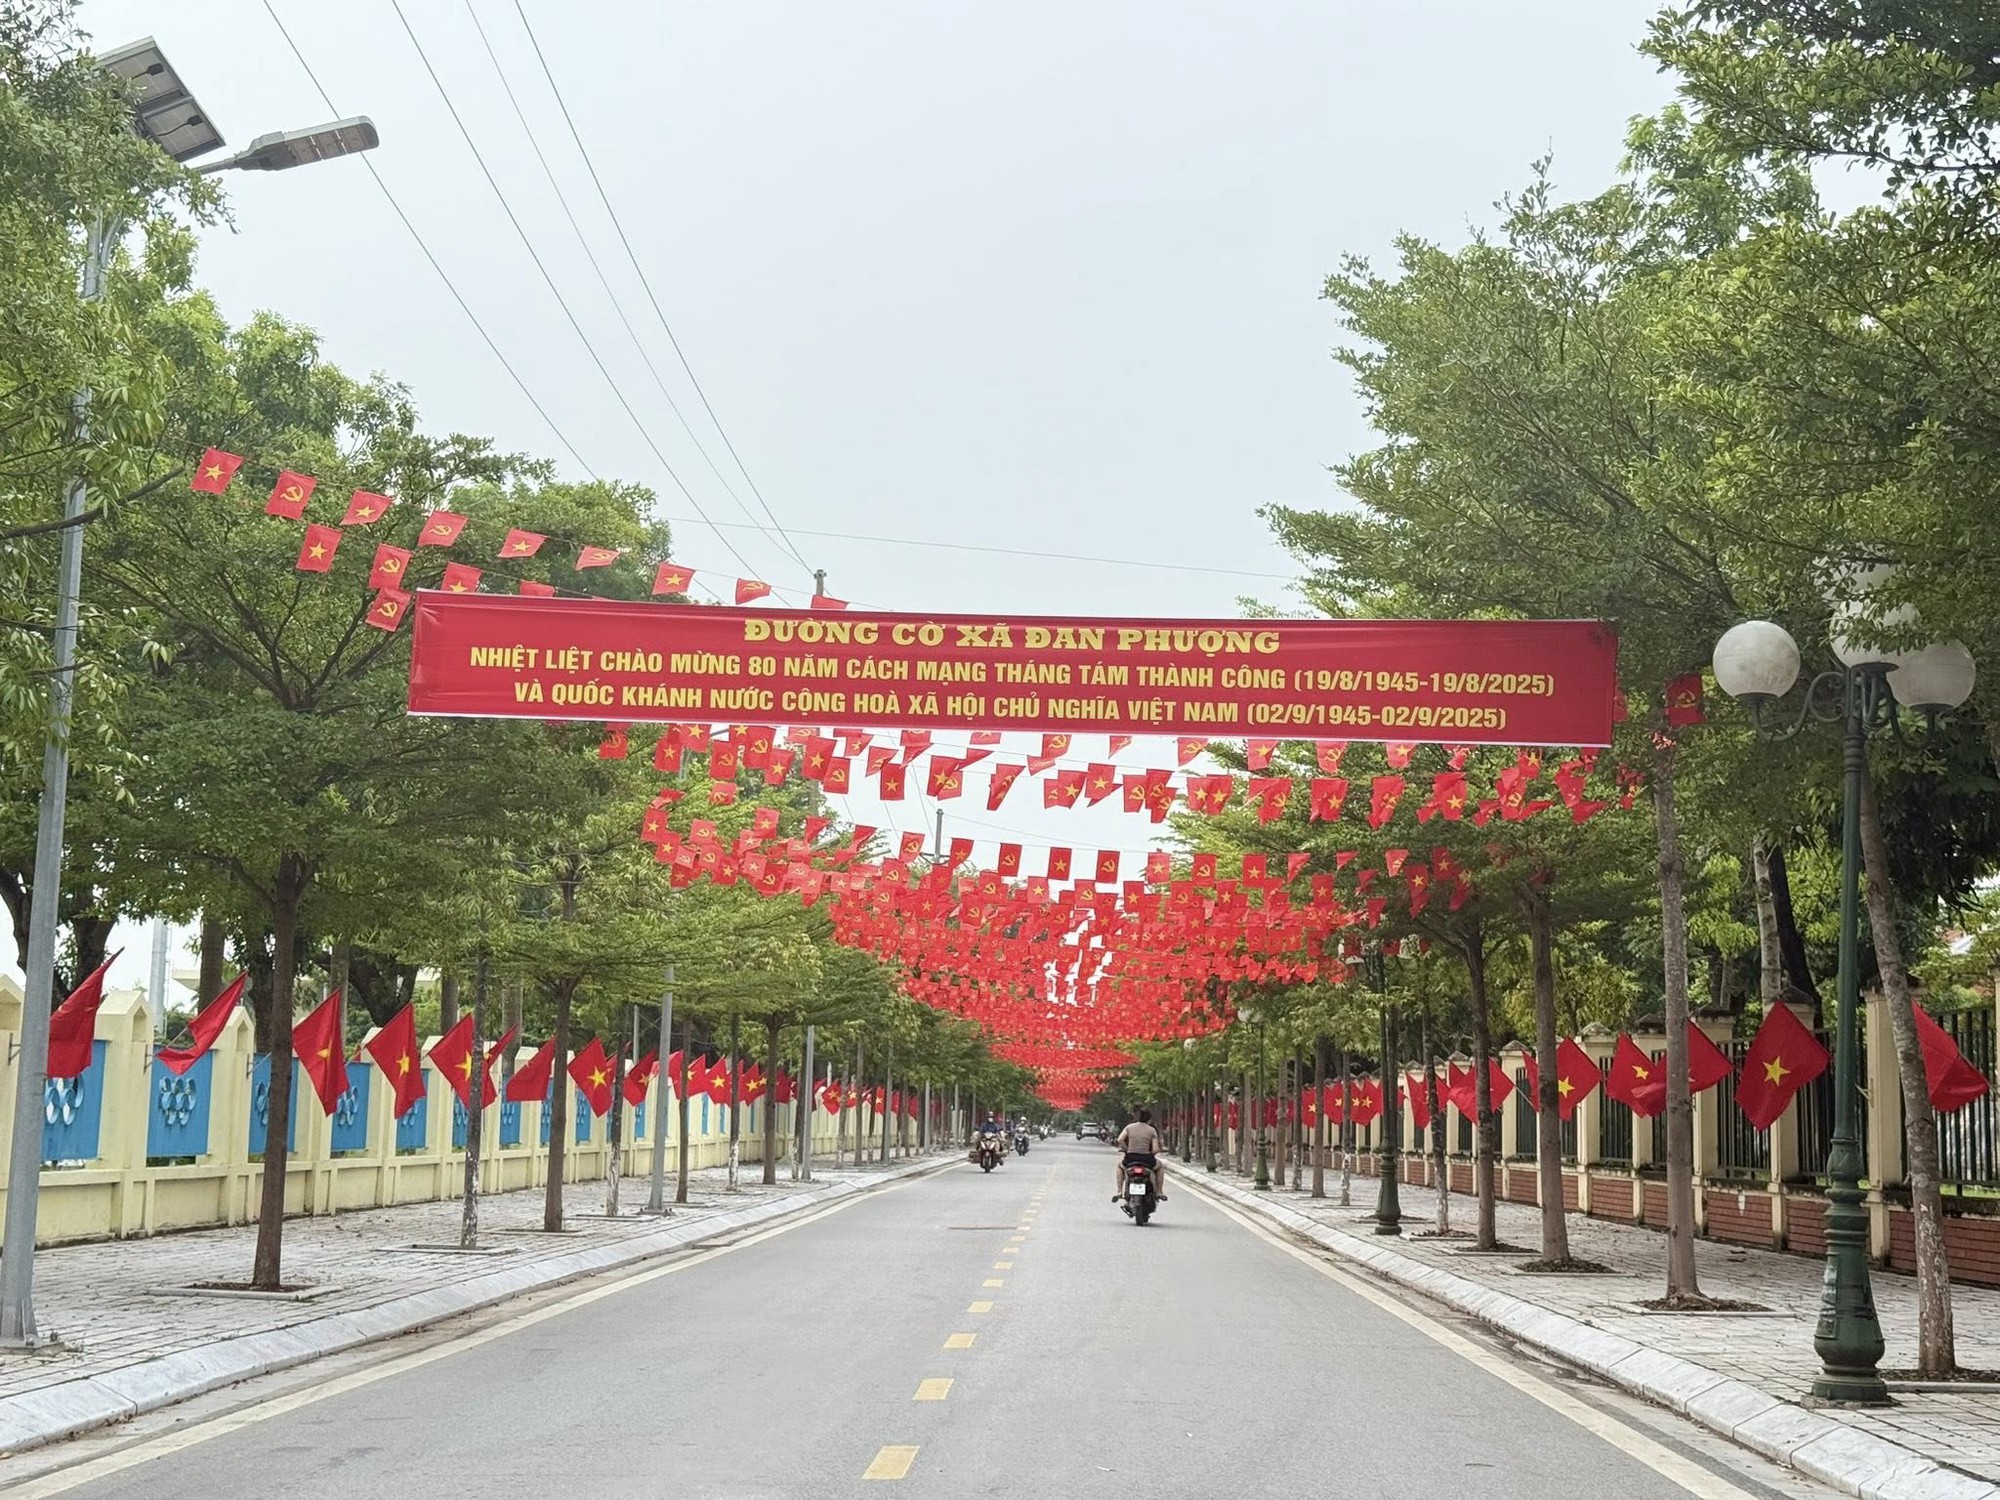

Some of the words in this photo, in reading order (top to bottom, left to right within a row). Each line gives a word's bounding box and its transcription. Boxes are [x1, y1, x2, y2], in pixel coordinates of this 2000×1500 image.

[744, 618, 879, 645] ĐƯỜNG
[891, 621, 945, 647] CỜ
[956, 622, 1014, 648] XÃ
[1024, 626, 1106, 651] ĐAN
[1117, 628, 1280, 657] PHƯỢNG
[470, 644, 538, 672] NHIỆT
[545, 645, 593, 674] LIỆT
[599, 648, 663, 673] CHÀO
[670, 650, 741, 676] MỪNG
[748, 655, 777, 677] 80
[783, 653, 839, 678] NĂM
[846, 655, 909, 680] CÁCH
[916, 660, 987, 686] MẠNG
[995, 660, 1071, 685] THÁNG
[1079, 661, 1129, 685] TÁM
[1137, 663, 1214, 688] THÀNH
[1221, 665, 1286, 689] CÔNG
[1294, 670, 1554, 697] (19/8/1945-19/8/2025)
[515, 679, 544, 703] VÀ
[551, 678, 614, 706] QUỐC
[621, 683, 703, 708] KHÁNH
[709, 686, 774, 711] NƯỚC
[781, 688, 846, 715] CỘNG
[853, 690, 901, 714] HOÀ
[908, 692, 939, 715] XÃ
[946, 692, 986, 719] HỘI
[993, 692, 1040, 718] CHỦ
[1047, 696, 1120, 720] NGHĨA
[1127, 697, 1175, 724] VIỆT
[1183, 702, 1239, 723] NAM
[1247, 703, 1506, 730] (02/9/1945-02/9/2025)
